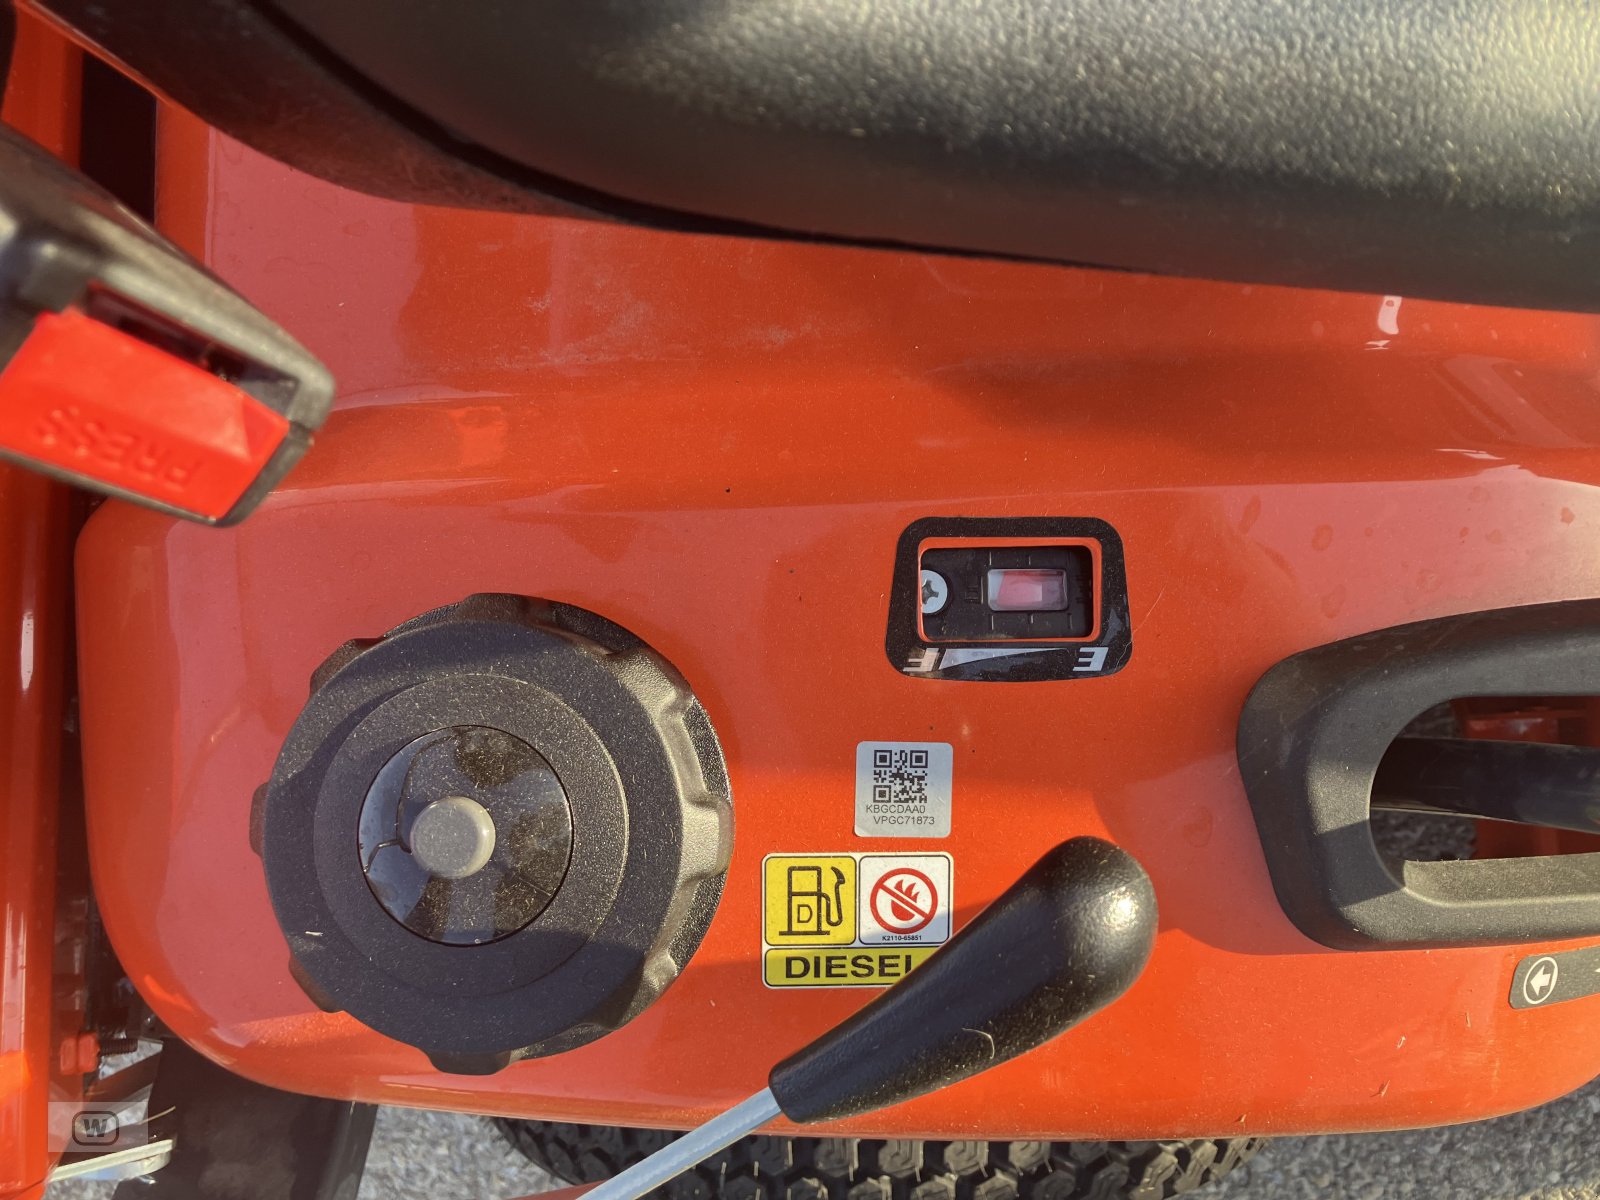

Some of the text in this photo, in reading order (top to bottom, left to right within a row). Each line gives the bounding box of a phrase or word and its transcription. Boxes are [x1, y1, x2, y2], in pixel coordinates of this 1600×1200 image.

[34, 405, 203, 493] PRESS
[902, 647, 939, 672] F
[1073, 647, 1109, 671] E
[873, 815, 935, 825] VPGC71873
[797, 904, 813, 923] D
